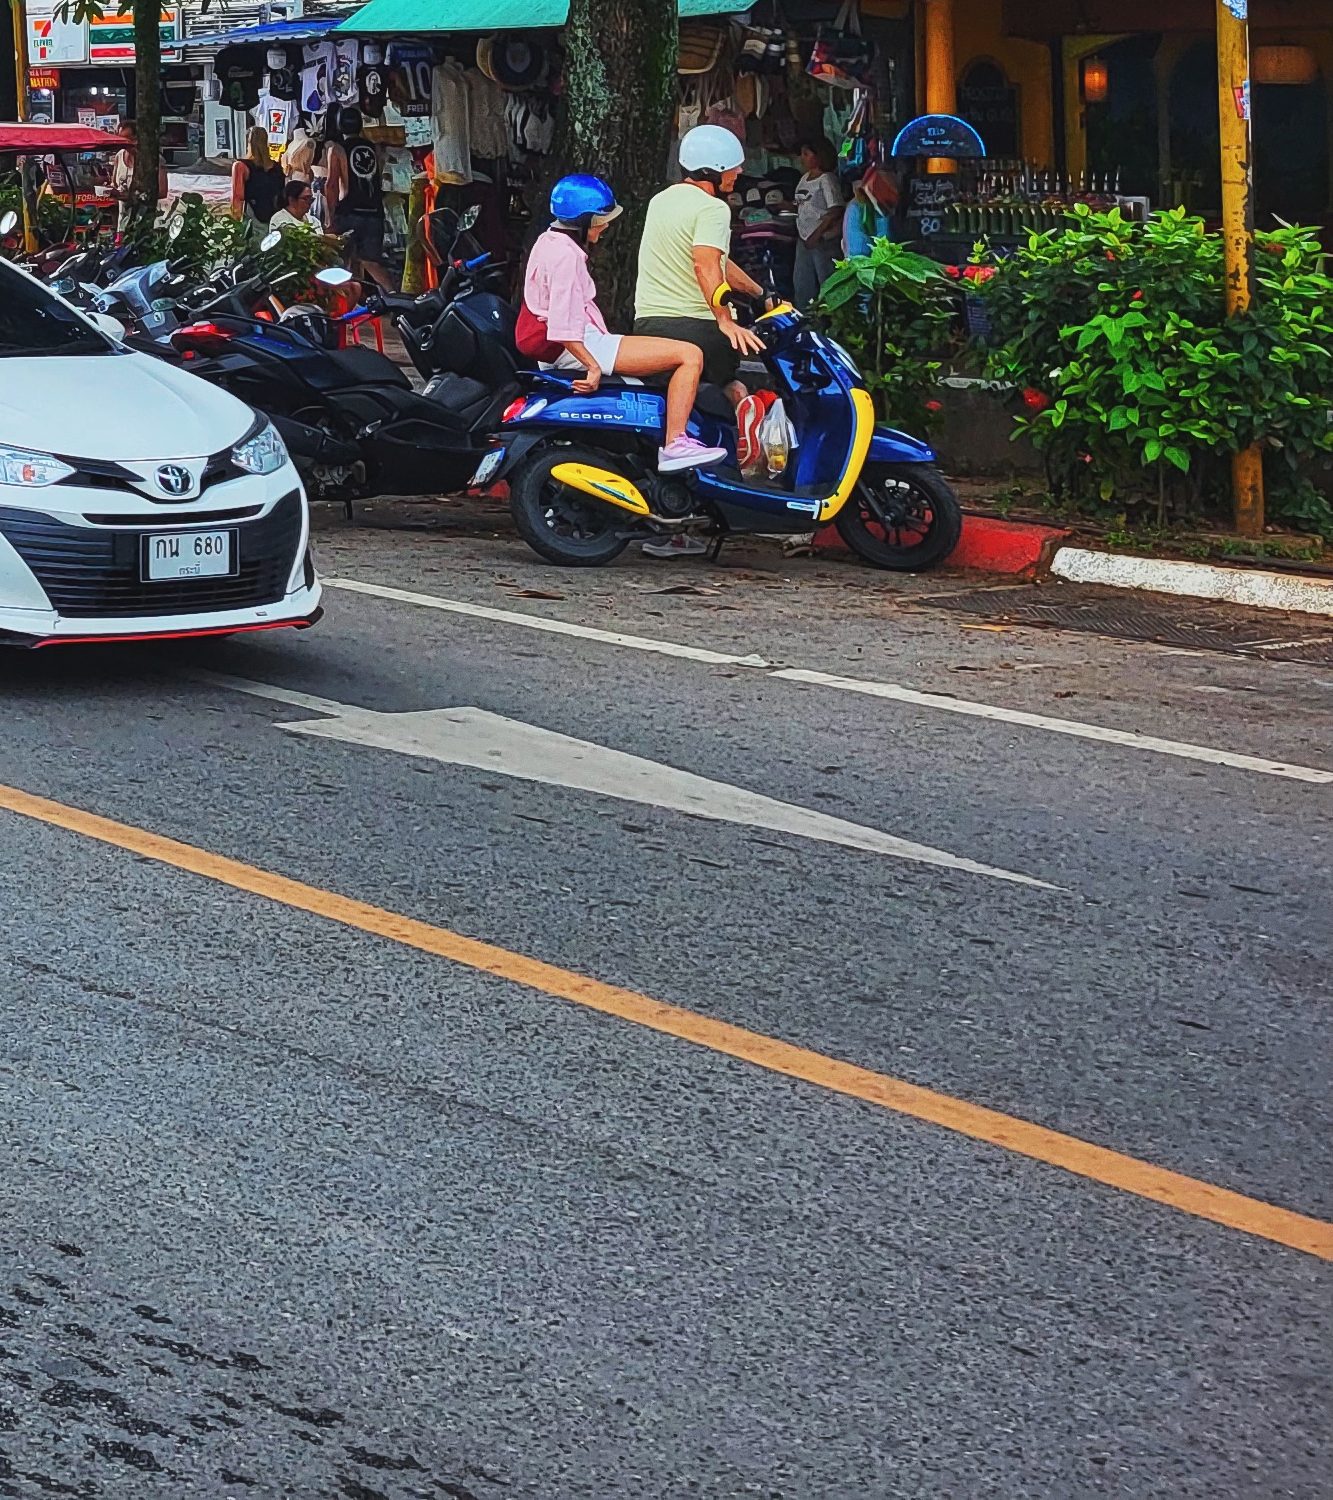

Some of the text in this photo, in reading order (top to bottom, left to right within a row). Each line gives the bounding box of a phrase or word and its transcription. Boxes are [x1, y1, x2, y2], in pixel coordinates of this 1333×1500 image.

[921, 217, 941, 236] 80
[155, 535, 223, 560] กน 680
